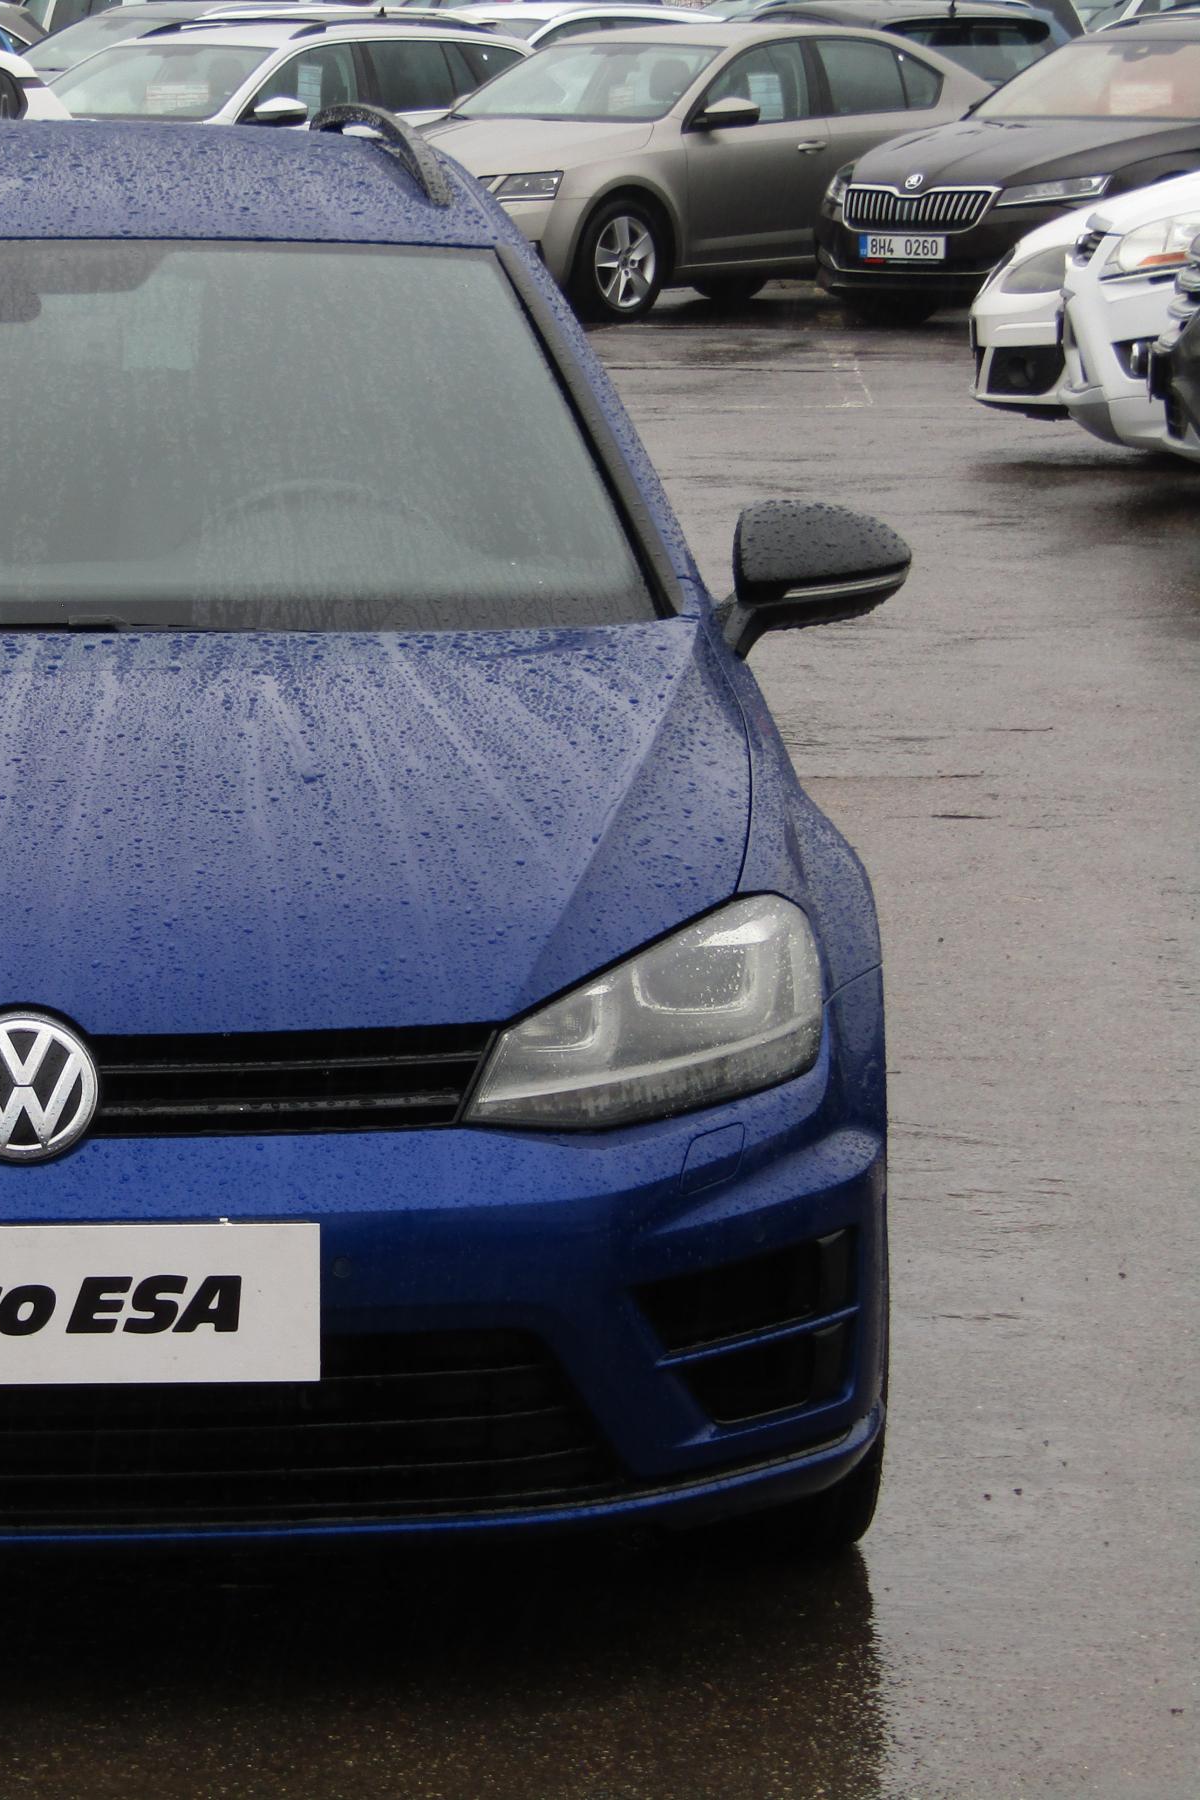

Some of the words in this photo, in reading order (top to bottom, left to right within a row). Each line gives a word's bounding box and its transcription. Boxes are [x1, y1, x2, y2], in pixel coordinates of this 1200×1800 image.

[870, 238, 894, 255] 8H4
[905, 239, 938, 256] 0260
[66, 1275, 243, 1335] ESA
